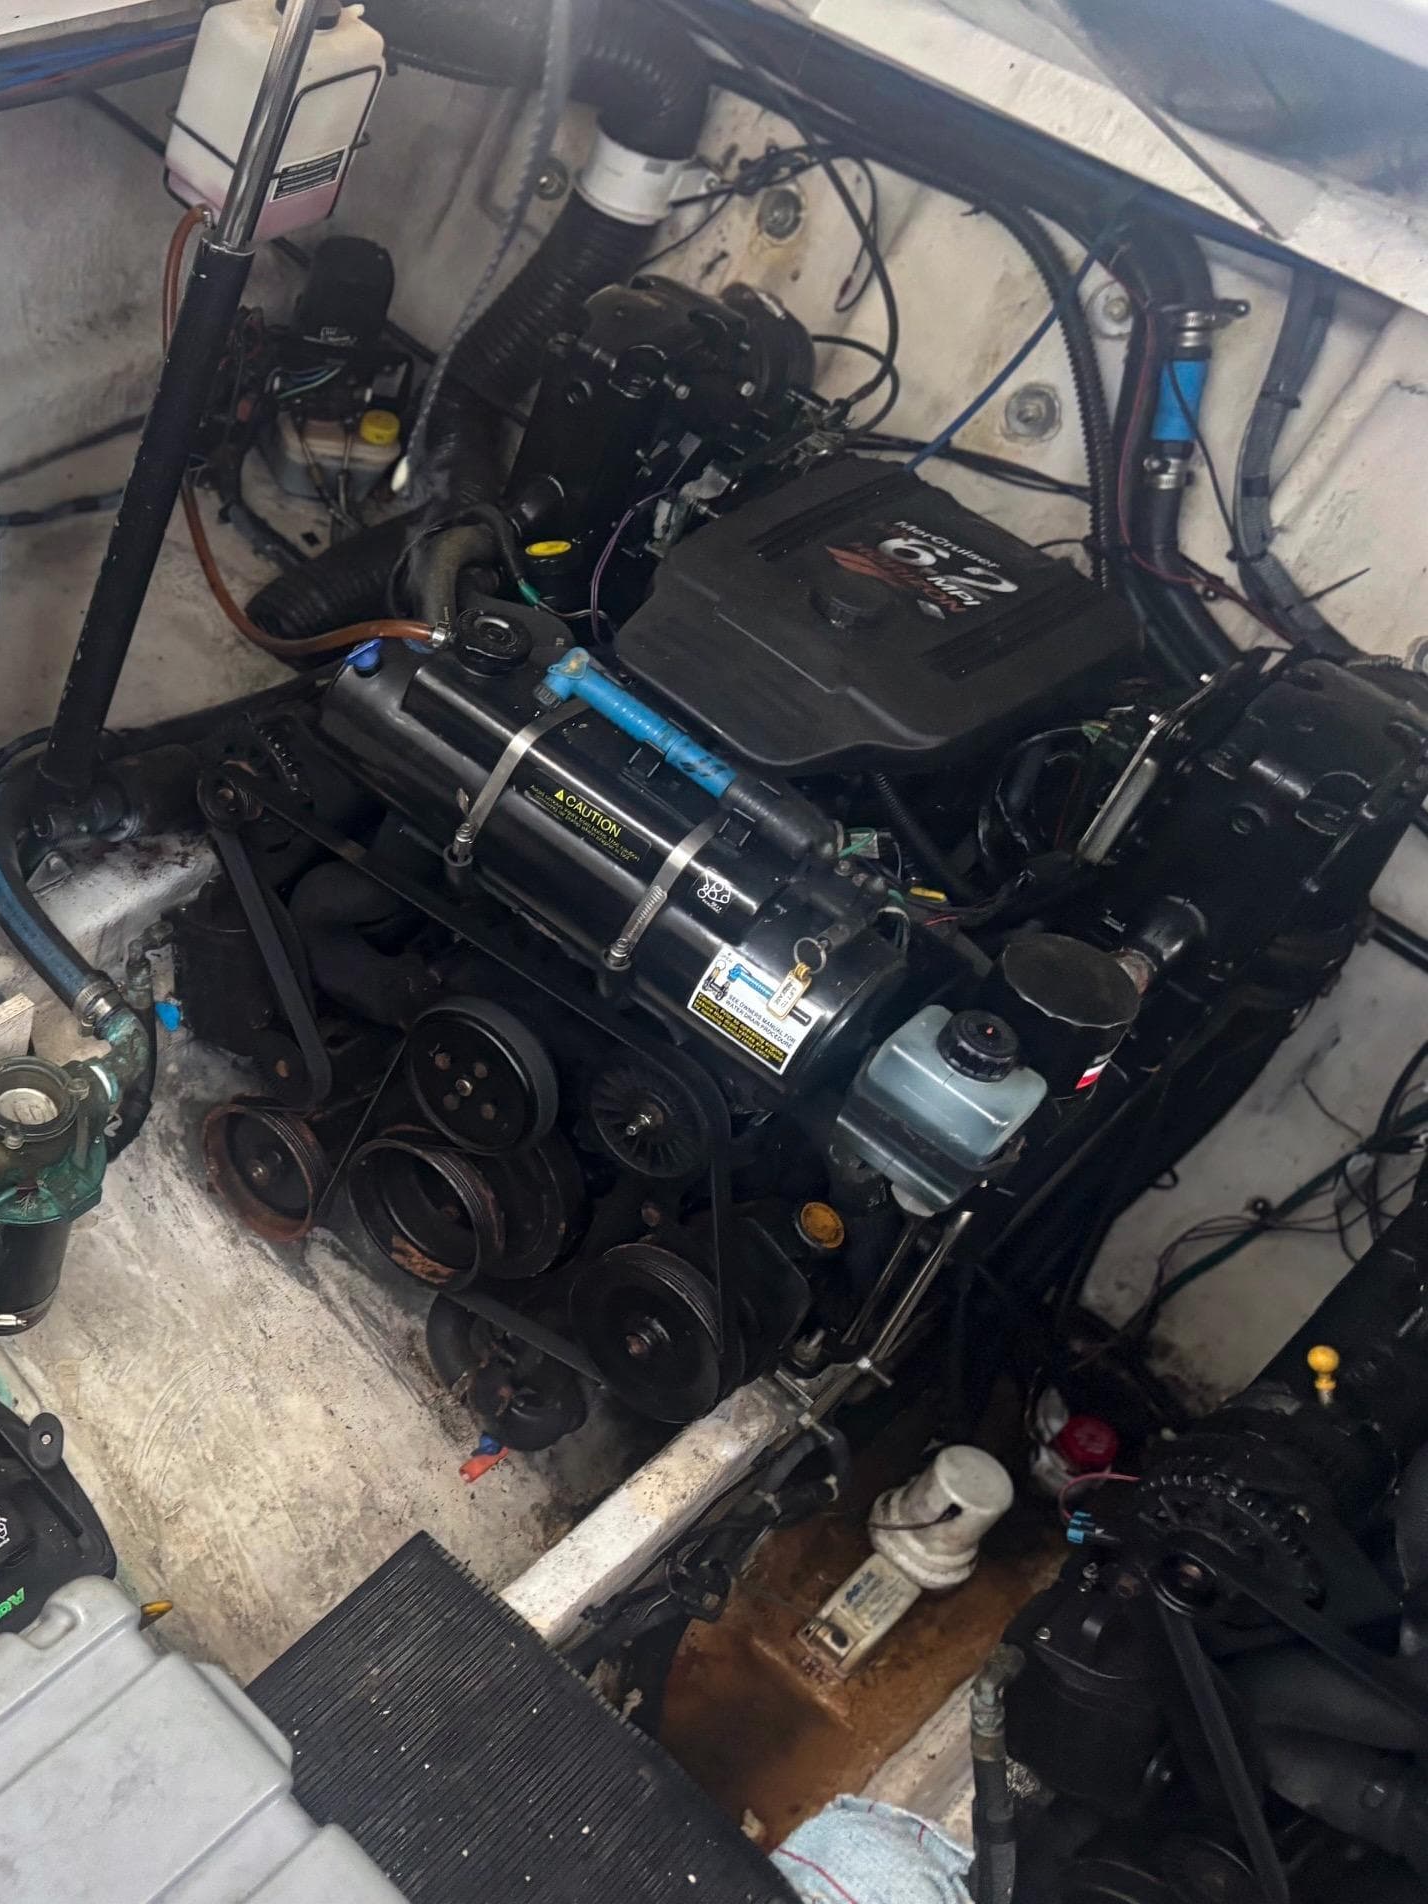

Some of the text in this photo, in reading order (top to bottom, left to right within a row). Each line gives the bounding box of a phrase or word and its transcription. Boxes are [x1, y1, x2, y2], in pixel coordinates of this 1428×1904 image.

[894, 521, 1002, 568] MerCruiser
[926, 576, 981, 606] MPI
[565, 795, 622, 838] CAUTION
